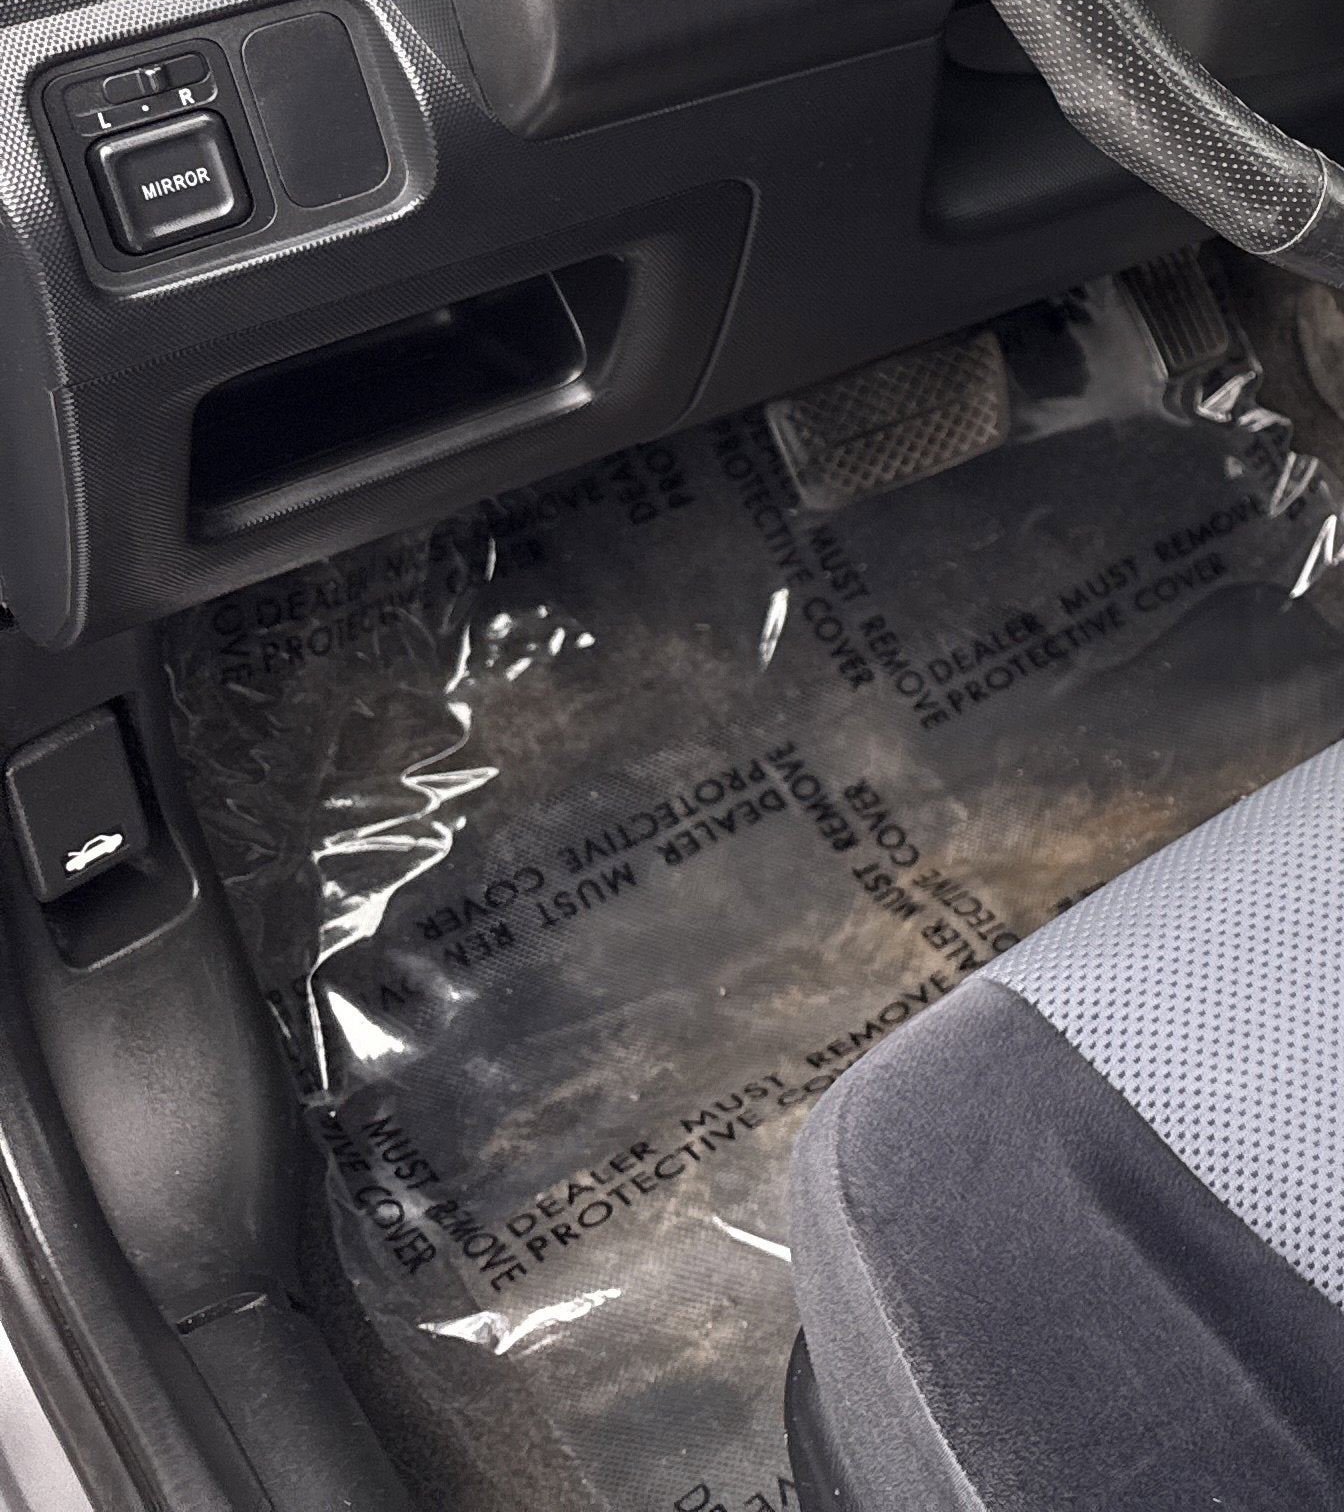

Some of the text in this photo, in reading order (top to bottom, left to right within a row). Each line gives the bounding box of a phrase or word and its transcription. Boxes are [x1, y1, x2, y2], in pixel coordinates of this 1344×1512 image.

[97, 111, 112, 130] L
[179, 87, 195, 106] R
[140, 166, 211, 202] MIRROR
[802, 595, 877, 692] COVER
[807, 524, 951, 732] MUST REMOVE
[927, 610, 1047, 687] DEALER
[1058, 554, 1142, 617] MUST
[945, 551, 1230, 717] PROTECTIVE COVER
[655, 787, 788, 868] DEALER
[763, 740, 859, 854] REMOVE
[843, 776, 921, 869] COVER
[416, 758, 768, 941] PROTECTIVE COVER
[536, 861, 639, 929] MUST
[850, 862, 926, 923] MUST
[505, 971, 952, 1238] DEALER MUST REMOVE
[354, 1185, 437, 1276] COVER
[362, 1114, 529, 1292] MUST REMOVE
[525, 1110, 766, 1265] PROTECTIVE
